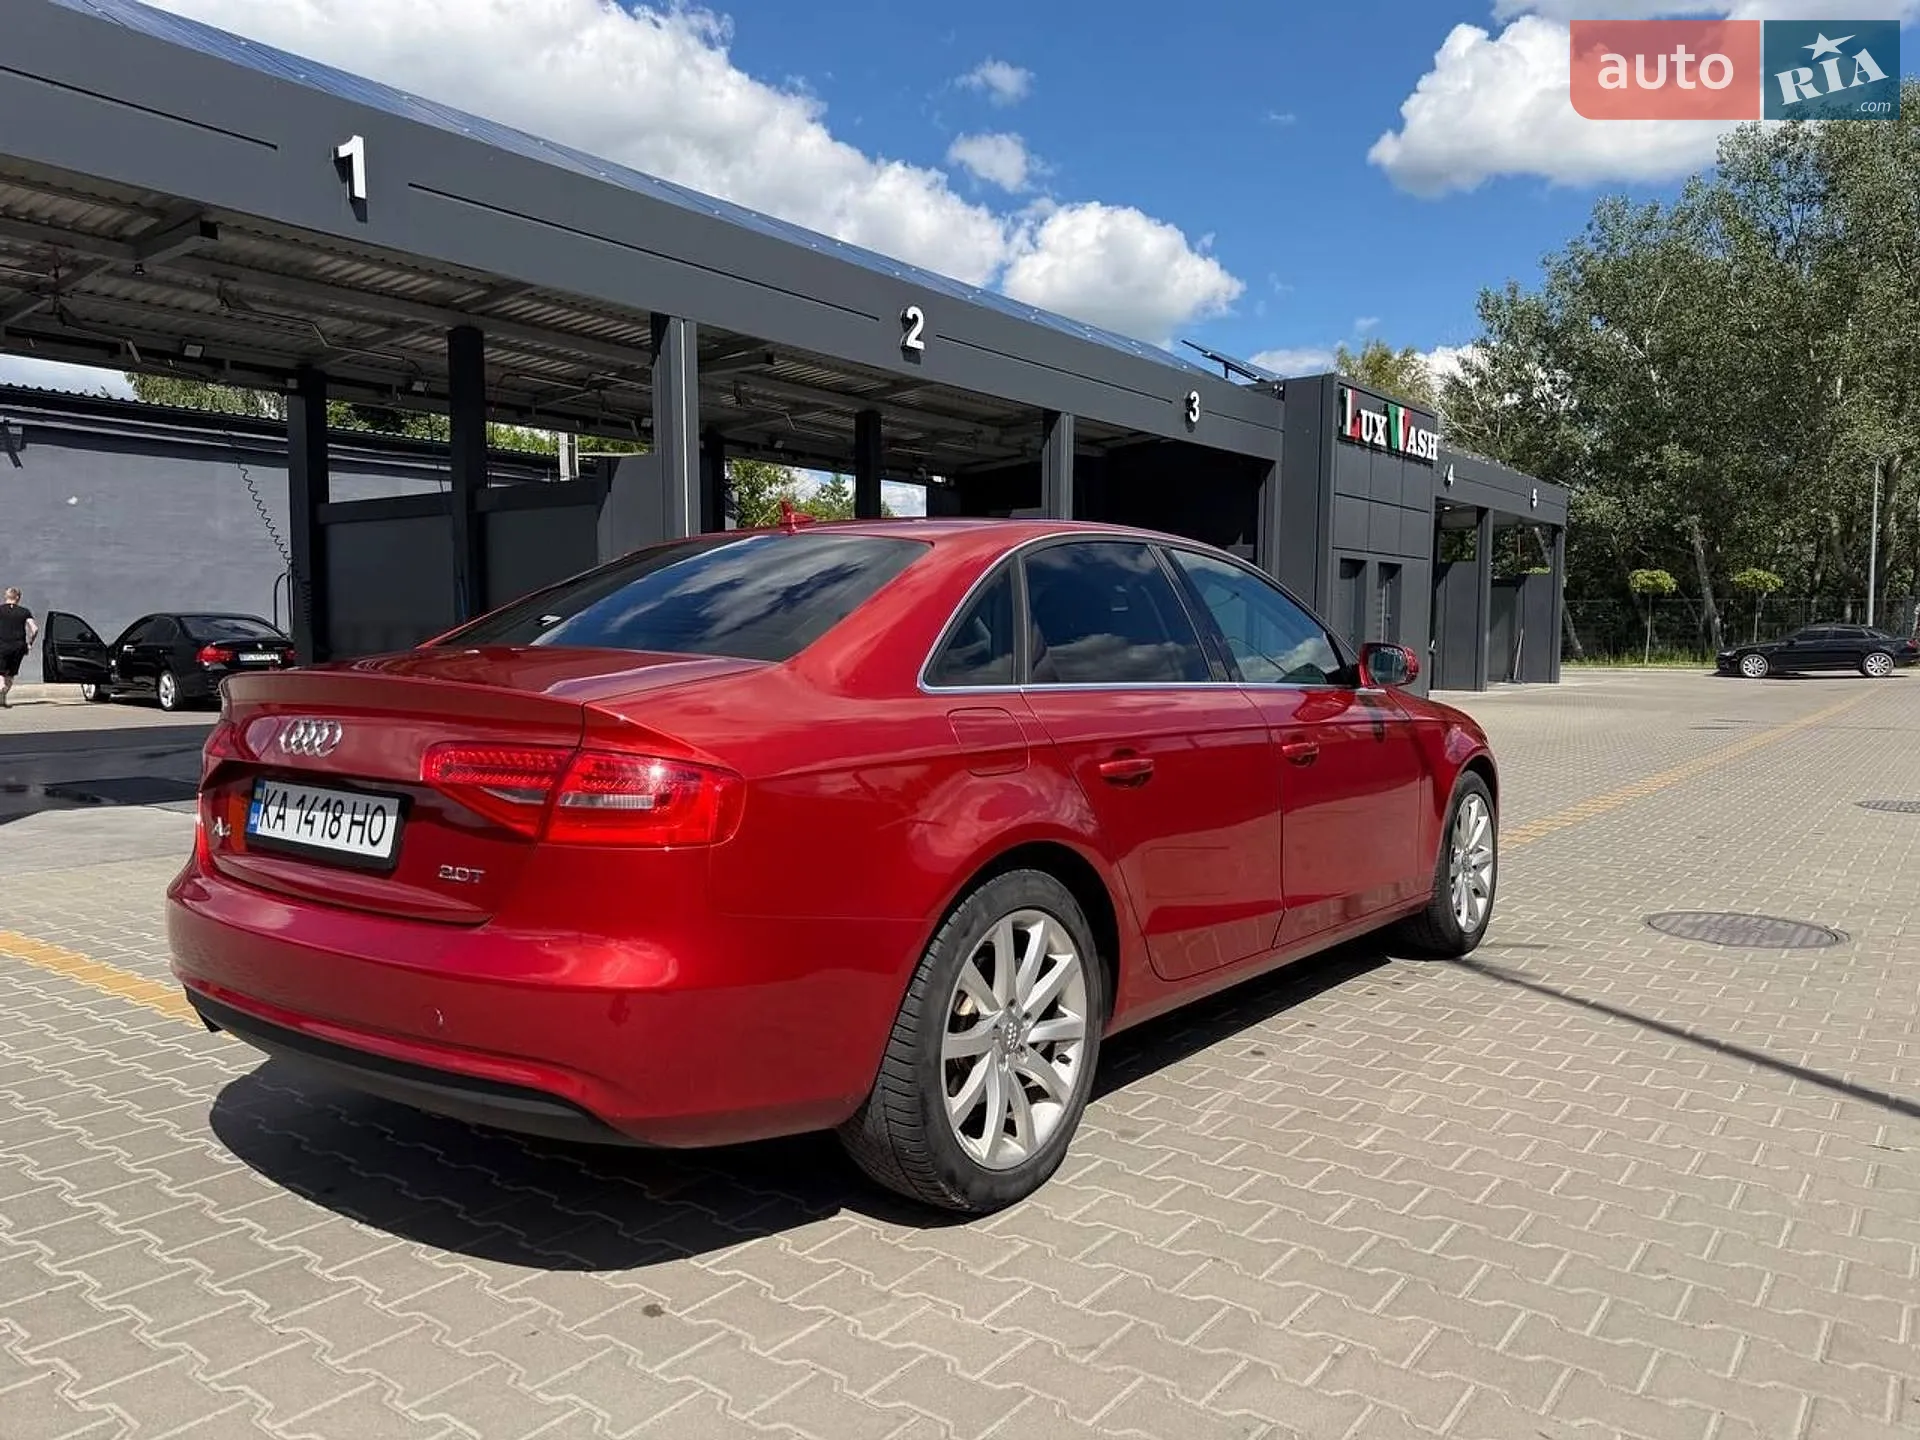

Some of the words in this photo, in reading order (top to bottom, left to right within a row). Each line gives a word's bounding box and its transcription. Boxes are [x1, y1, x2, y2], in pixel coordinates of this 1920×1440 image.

[337, 134, 366, 199] 1
[905, 305, 925, 350] 2
[1189, 390, 1200, 423] 3
[1446, 463, 1454, 487] 4
[260, 788, 288, 833] KA
[296, 794, 345, 840] 1418
[346, 801, 387, 847] HO
